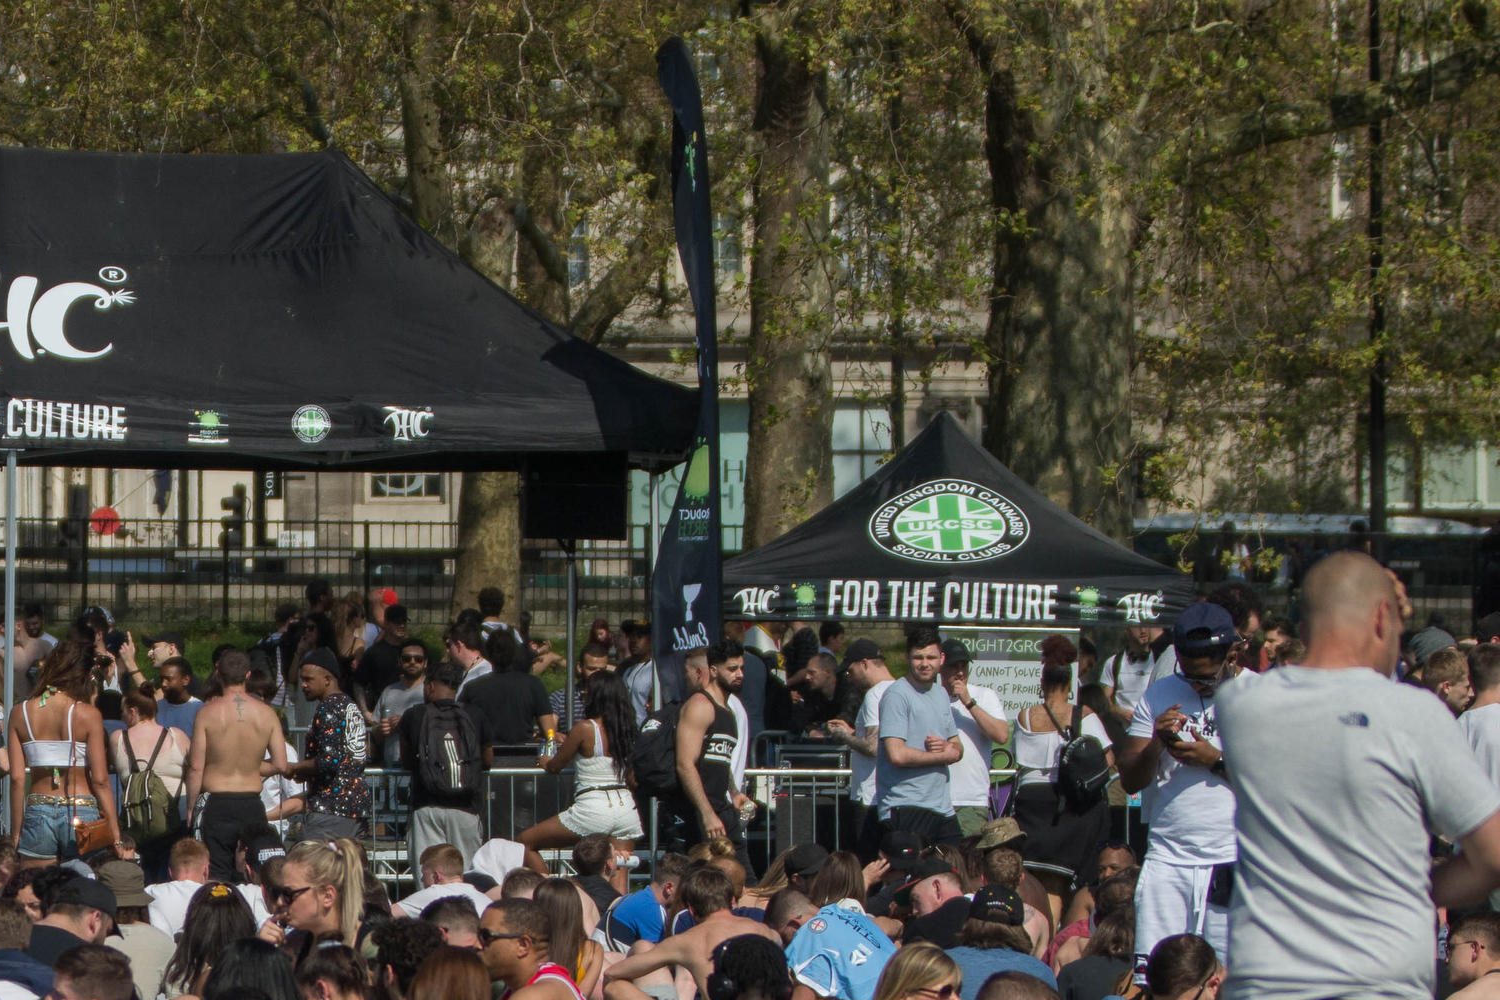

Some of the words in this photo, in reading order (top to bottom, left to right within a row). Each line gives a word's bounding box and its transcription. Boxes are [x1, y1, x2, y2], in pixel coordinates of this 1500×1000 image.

[7, 399, 127, 440] CULTURE
[875, 505, 898, 538] UNITED
[895, 483, 976, 507] KINGDOM
[977, 491, 1025, 537] CANNABIS
[908, 519, 993, 531] UKCSC
[892, 543, 953, 561] SOCIAL
[958, 542, 1013, 561] CLUBS
[827, 579, 880, 617] FOR
[887, 580, 937, 618] THE
[943, 582, 1059, 621] CULTURE
[996, 682, 1010, 694] OF
